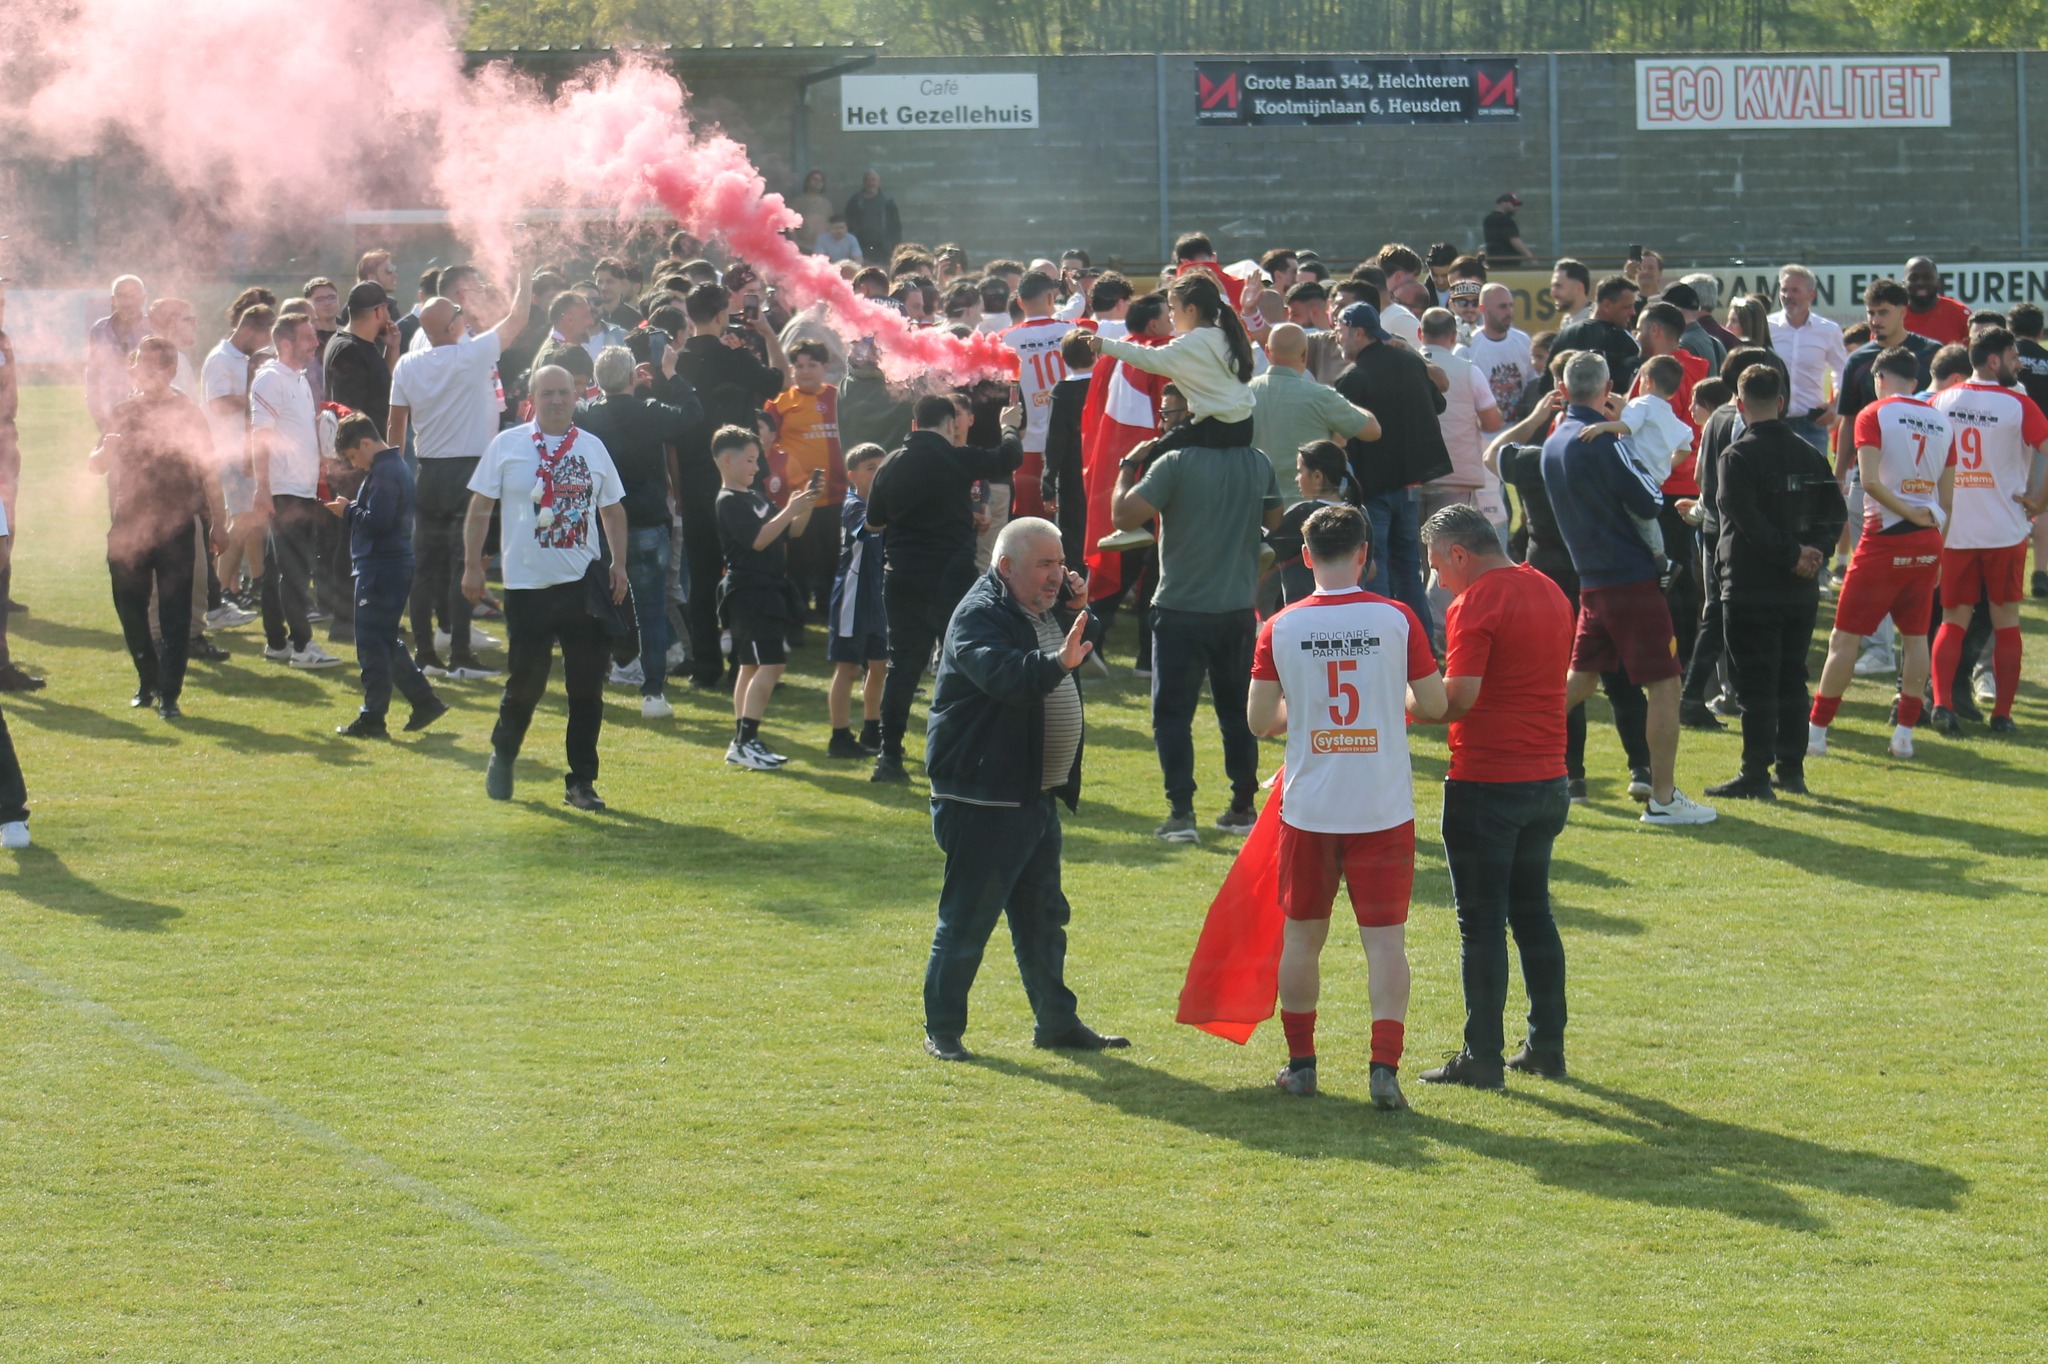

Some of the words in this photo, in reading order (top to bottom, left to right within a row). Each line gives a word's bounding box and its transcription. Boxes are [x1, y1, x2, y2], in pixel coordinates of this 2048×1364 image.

[920, 79, 959, 96] Café
[1244, 75, 1291, 90] Grote
[1295, 74, 1337, 89] Baan
[1340, 74, 1374, 92] 342,
[1378, 72, 1470, 89] Helchteren
[1647, 66, 1723, 121] ECO
[1735, 64, 1940, 120] KWALITEIT
[847, 107, 888, 125] Het
[896, 105, 1033, 124] Gezellehuis
[1254, 99, 1367, 117] Koolmijnlaan
[1369, 99, 1384, 115] 6,
[1388, 98, 1462, 113] Heusden
[1713, 274, 1835, 309] RAMN
[1938, 271, 2048, 303] EUREN
[1028, 350, 1067, 390] 10
[1912, 433, 1926, 467] 7
[1961, 427, 1982, 470] 9
[1310, 629, 1370, 640] FIDUCIAIRE
[1312, 646, 1370, 657] PARTNERS
[1327, 660, 1360, 726] 5
